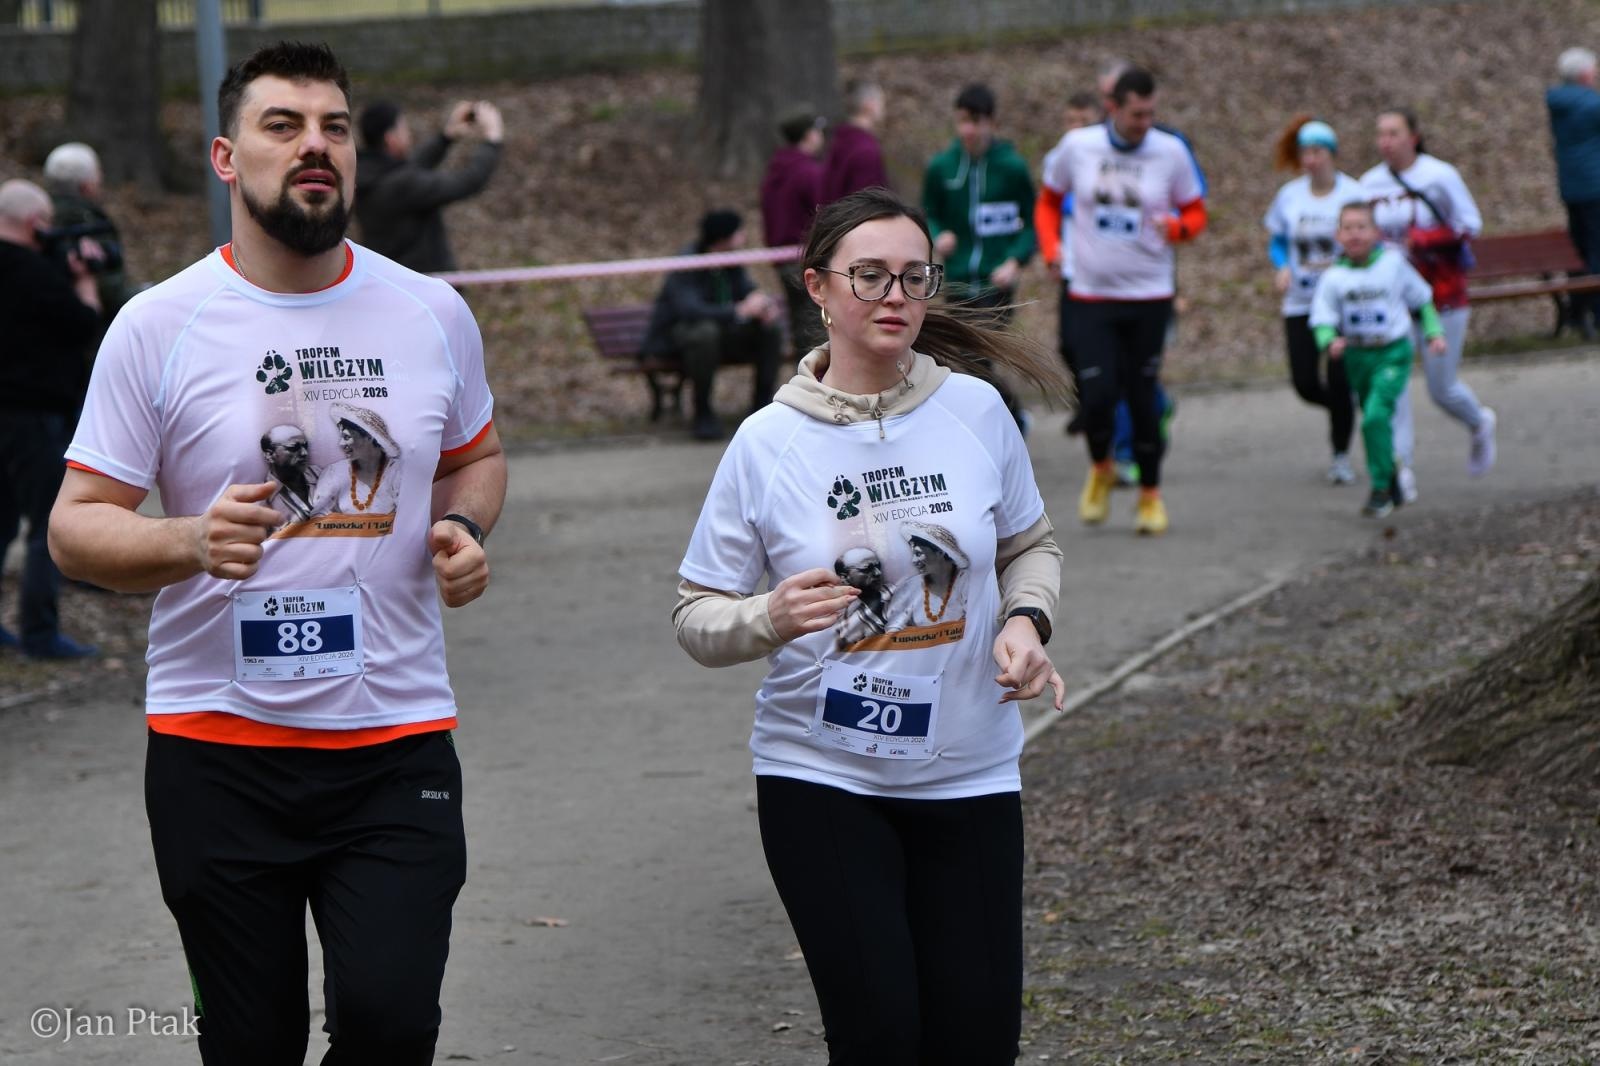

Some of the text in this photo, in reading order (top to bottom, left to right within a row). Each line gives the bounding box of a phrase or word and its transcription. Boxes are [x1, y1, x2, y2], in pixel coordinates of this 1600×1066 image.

[295, 347, 341, 360] TROPEM
[299, 359, 385, 380] WILCZYM
[304, 387, 388, 401] XIV EDYCJA 2026
[862, 466, 905, 484] TROPEM
[866, 473, 947, 503] WILCZYM
[873, 501, 953, 523] XIV EDYCJA 2026
[283, 601, 326, 614] WILCZYM
[278, 620, 323, 654] 88
[338, 651, 354, 659] 2026
[872, 676, 893, 686] TROPEM
[871, 683, 911, 698] WILCZYM
[857, 699, 902, 734] 20
